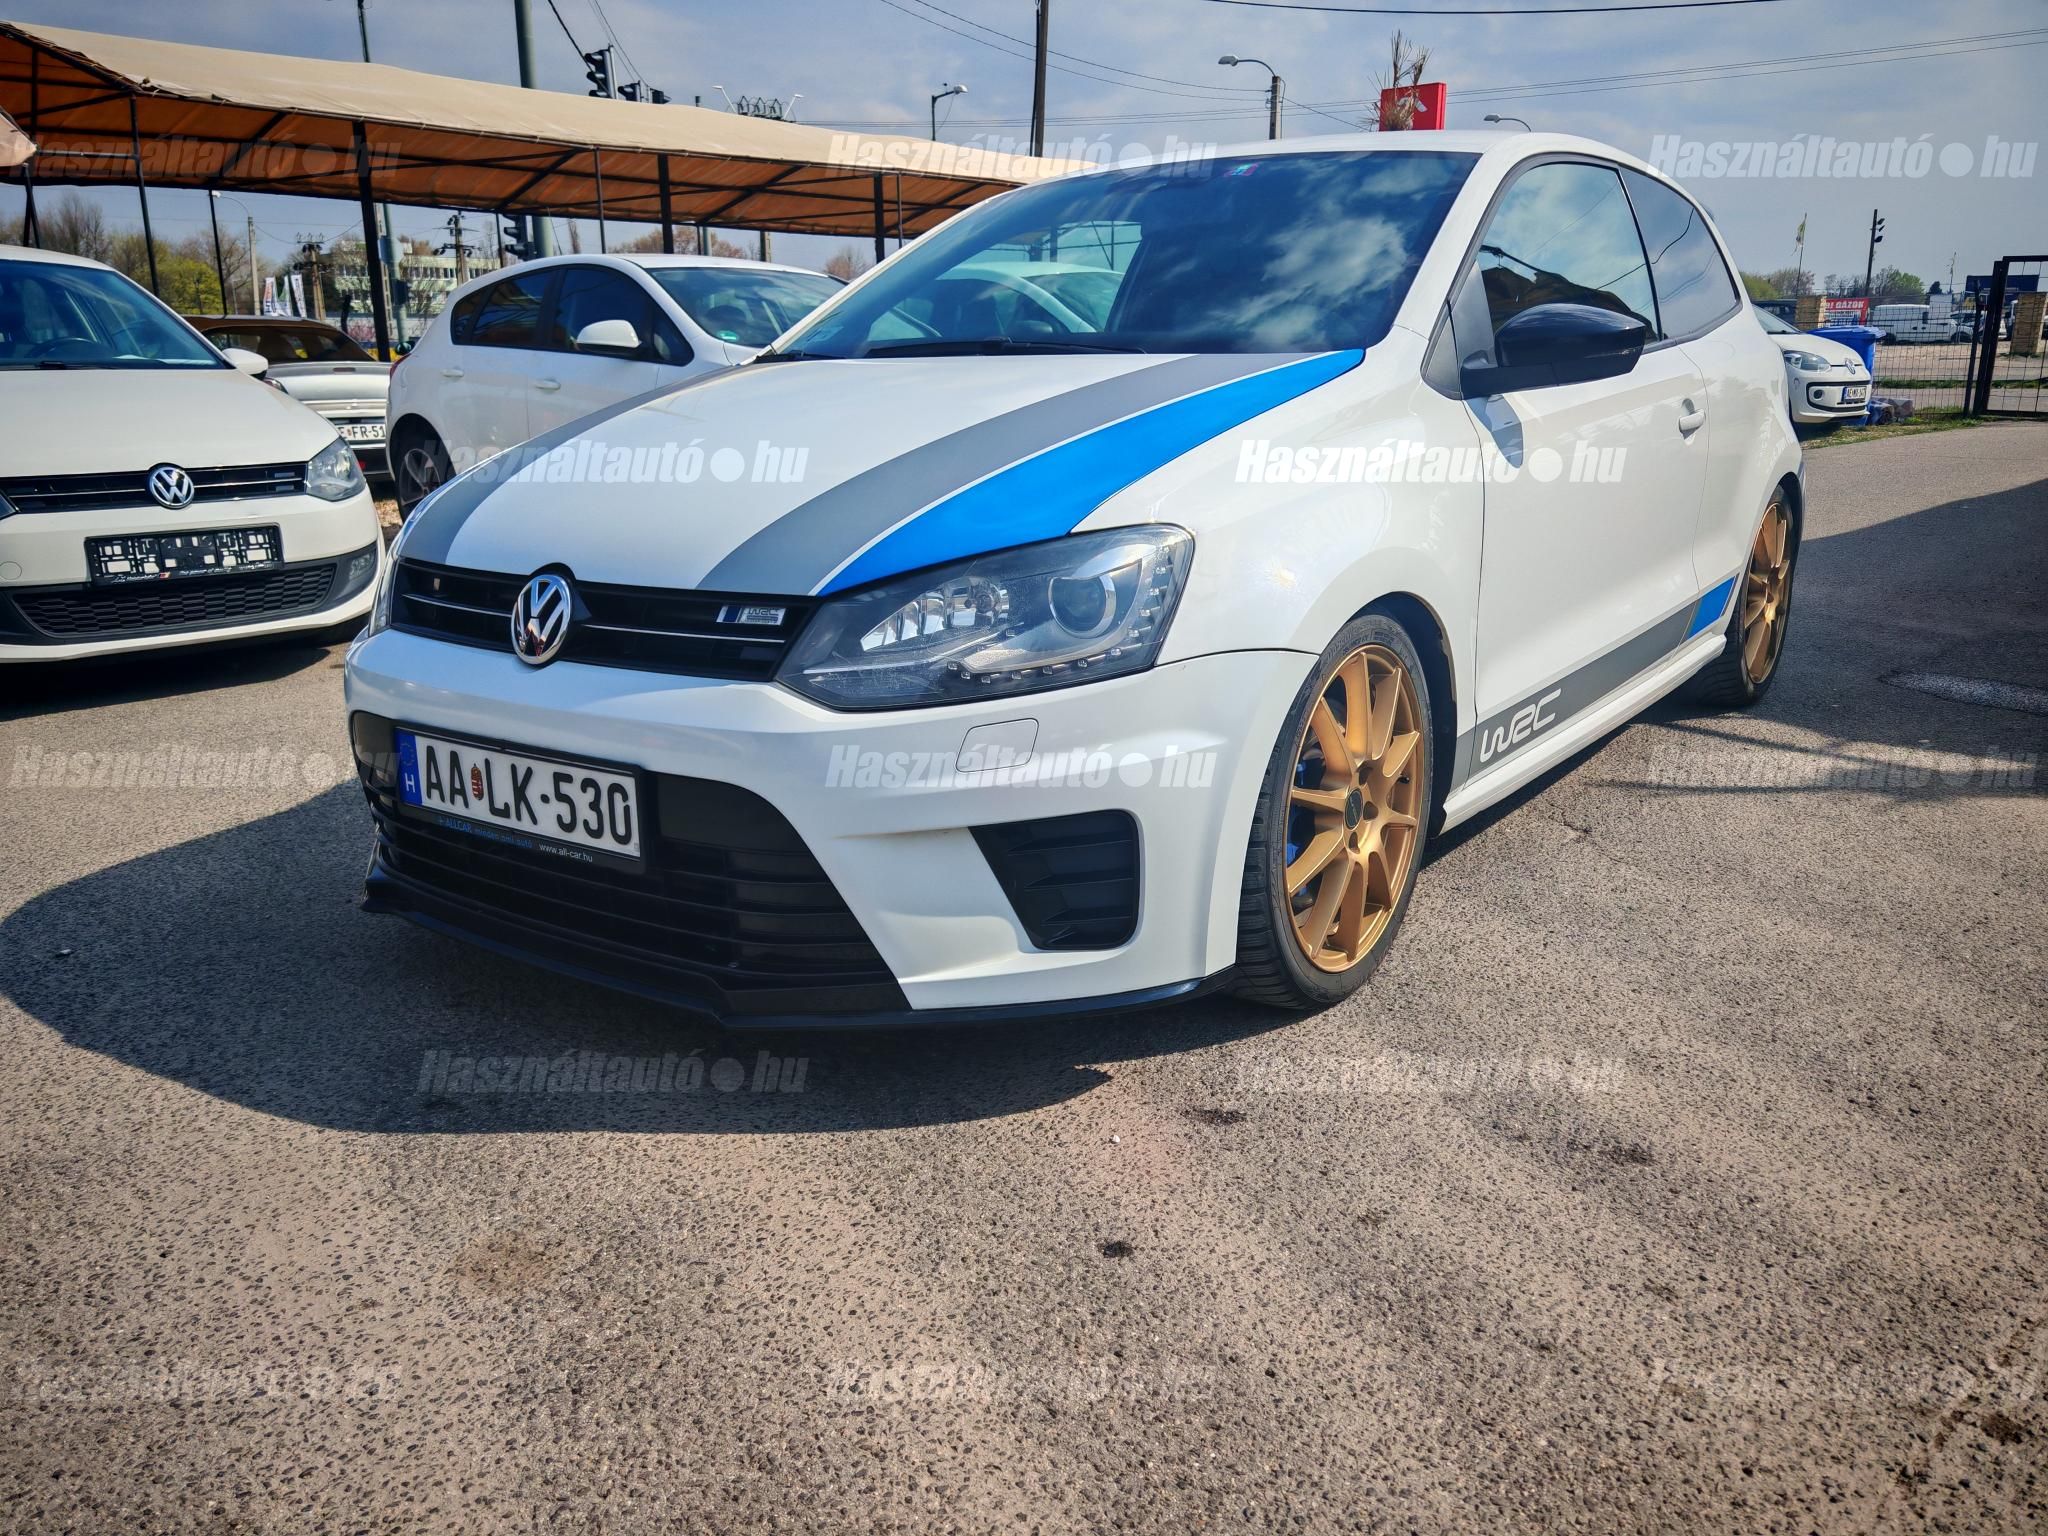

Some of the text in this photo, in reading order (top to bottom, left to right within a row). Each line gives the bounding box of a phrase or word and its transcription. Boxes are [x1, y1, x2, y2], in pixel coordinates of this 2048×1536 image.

[1480, 688, 1562, 763] WRC
[404, 773, 416, 793] H
[426, 745, 632, 845] AA LK-530
[538, 843, 593, 862] www.all-car.hu
